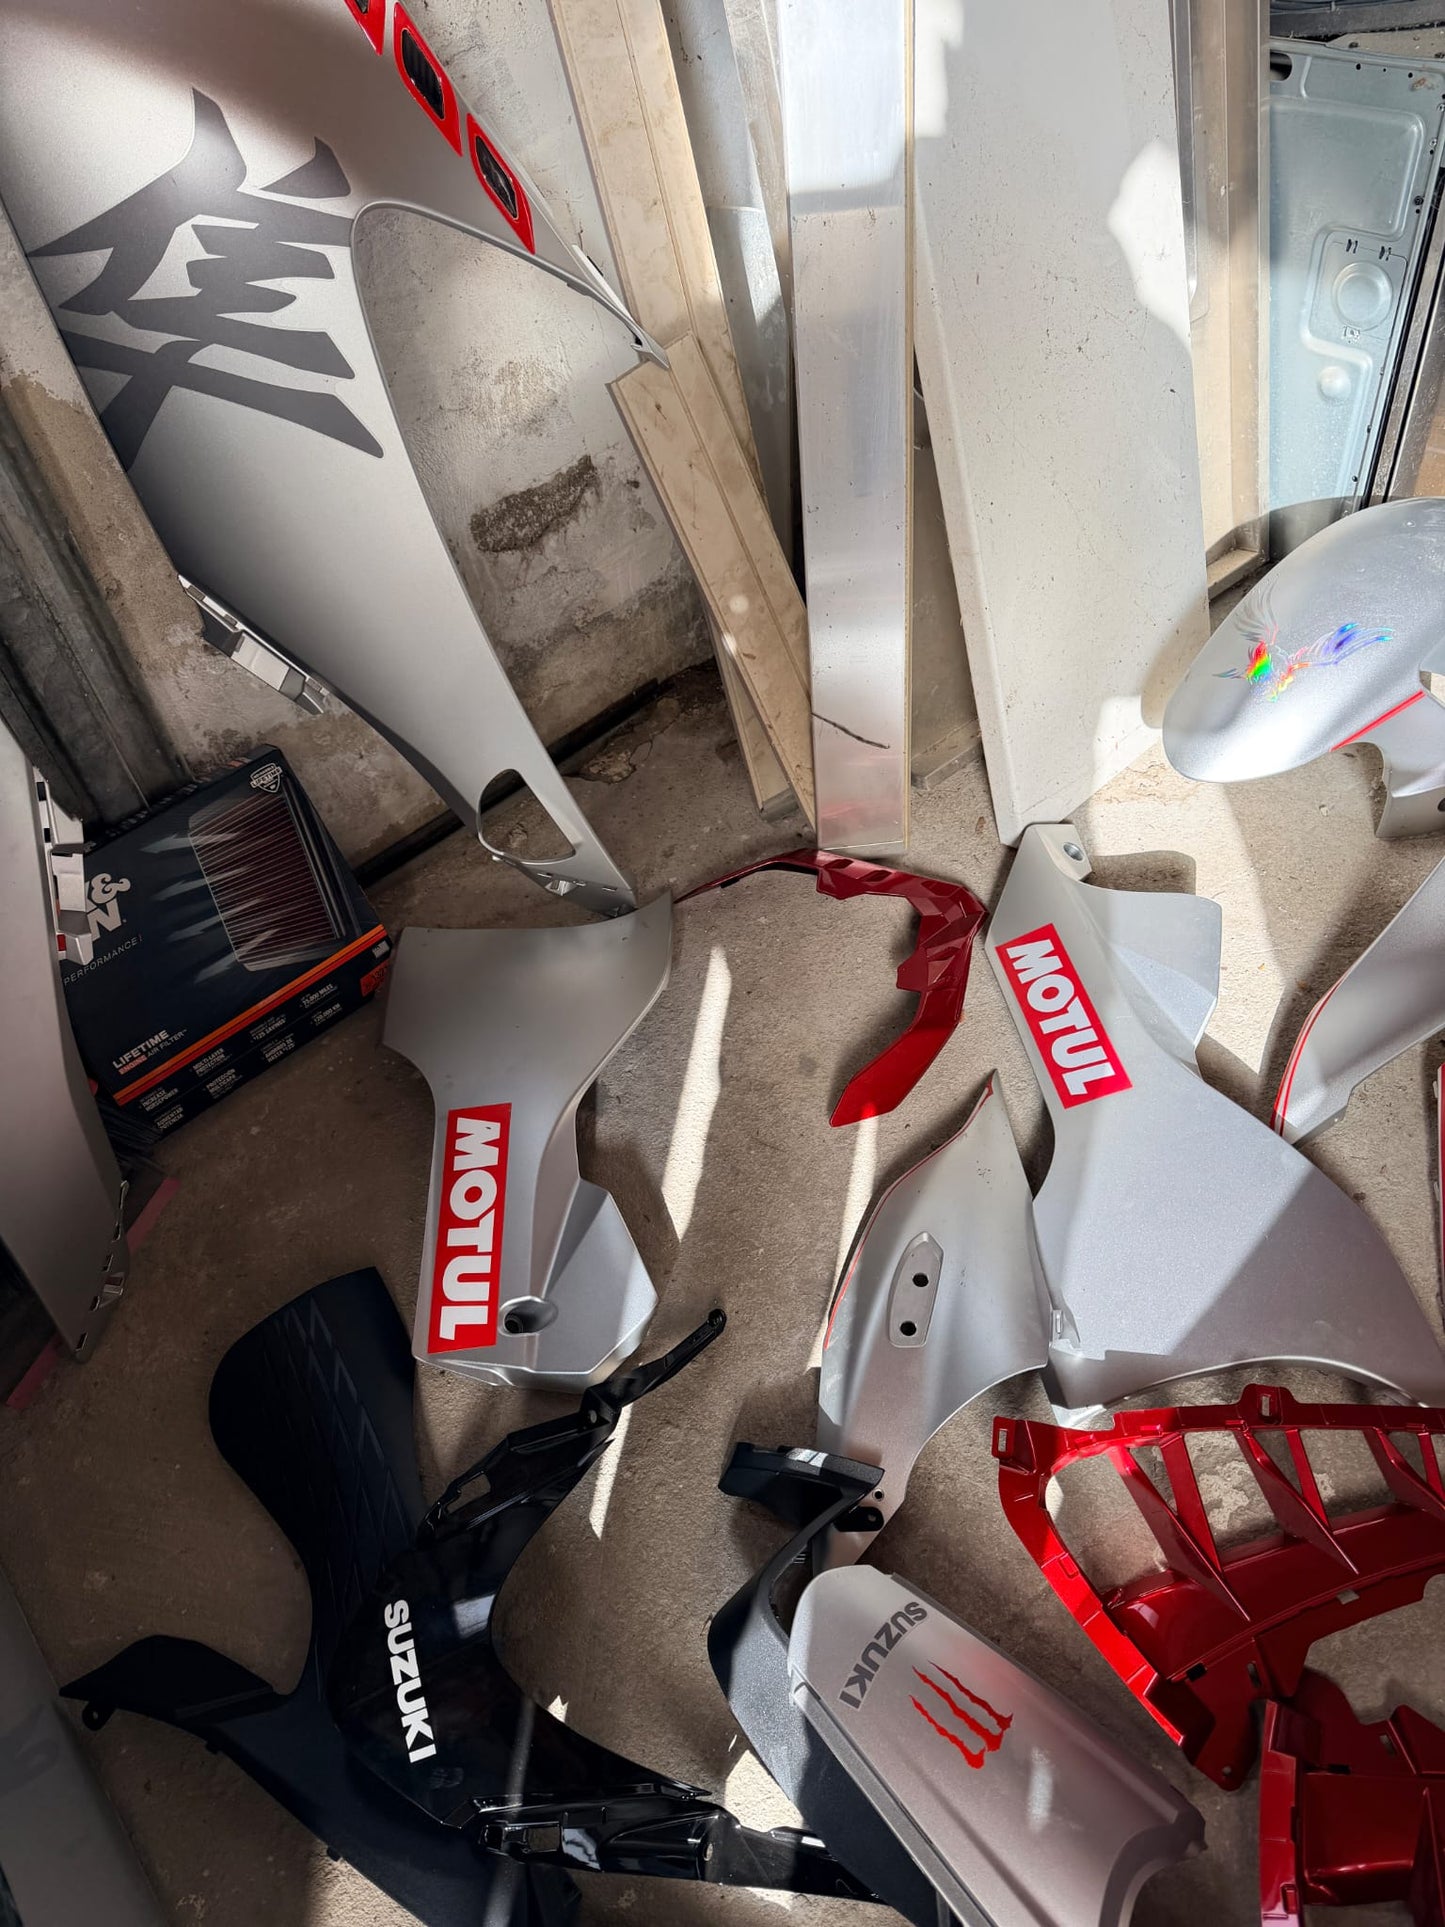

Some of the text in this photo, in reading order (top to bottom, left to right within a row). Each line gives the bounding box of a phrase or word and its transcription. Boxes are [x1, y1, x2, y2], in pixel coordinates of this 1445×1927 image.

[112, 1029, 170, 1069] LIFETIME
[147, 1047, 160, 1058] AIR
[1006, 939, 1116, 1096] MOTUL
[439, 1117, 500, 1340] MOTUL
[384, 1600, 437, 1763] SUZUKI
[839, 1602, 927, 1709] SUZUKI
